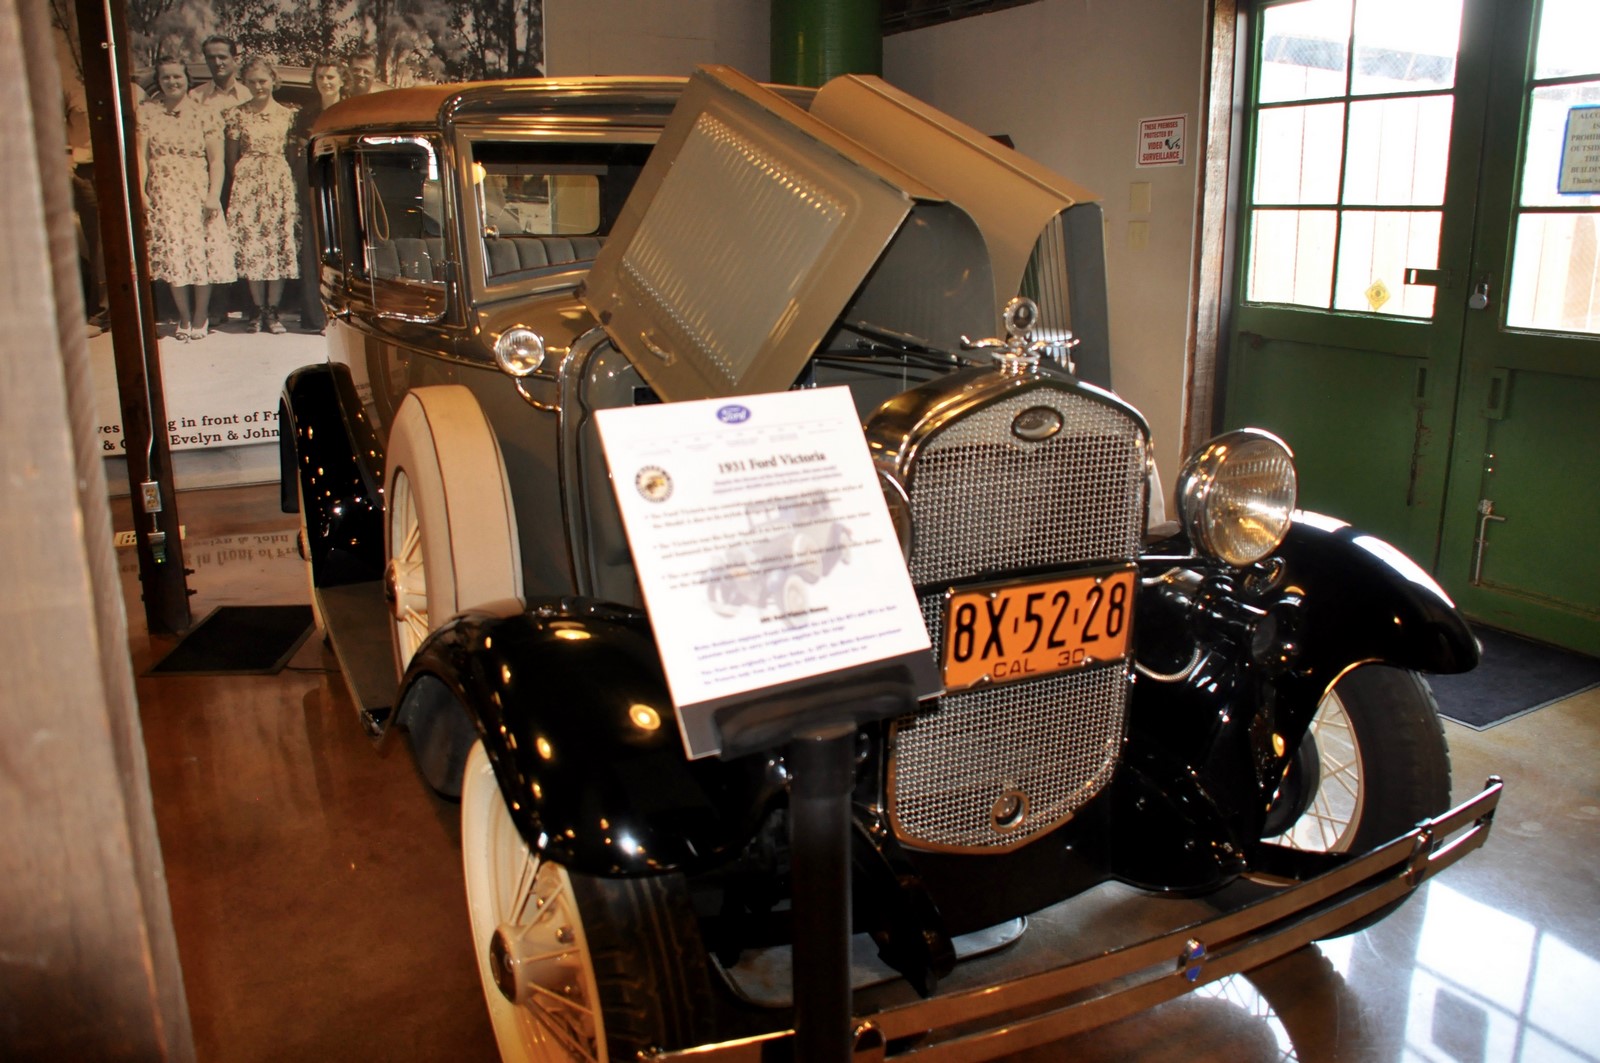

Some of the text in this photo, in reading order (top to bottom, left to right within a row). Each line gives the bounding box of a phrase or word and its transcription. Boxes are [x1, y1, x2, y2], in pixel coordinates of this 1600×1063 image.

[1158, 121, 1178, 129] PREMISES
[1144, 131, 1167, 139] PROTECTED
[1148, 141, 1163, 150] VIDEO
[1143, 151, 1180, 161] SURVEILLANCE
[181, 417, 197, 428] in
[202, 414, 239, 426] front
[244, 411, 259, 423] of
[170, 432, 222, 445] Evelyn
[227, 430, 239, 441] &
[243, 428, 280, 440] John
[718, 451, 826, 474] 1931 Ford Victoria
[993, 648, 1086, 678] CAL 30
